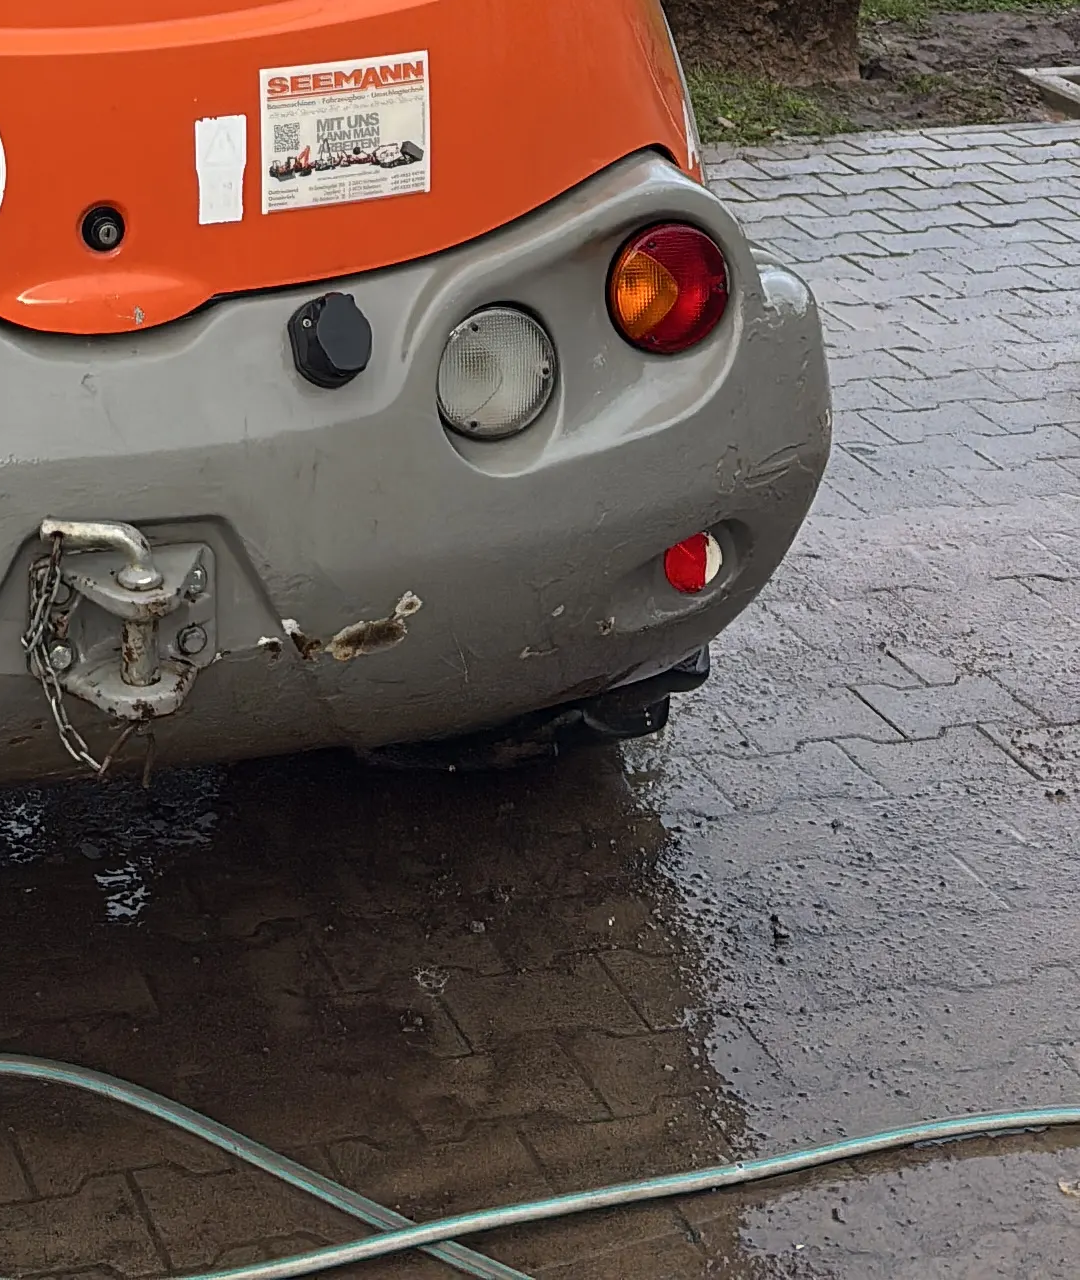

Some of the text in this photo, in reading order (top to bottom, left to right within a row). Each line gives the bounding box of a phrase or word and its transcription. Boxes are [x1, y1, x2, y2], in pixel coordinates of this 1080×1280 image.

[267, 60, 424, 96] SEEMANN
[317, 112, 380, 132] MIT UNS
[317, 126, 380, 143] KANN MAN
